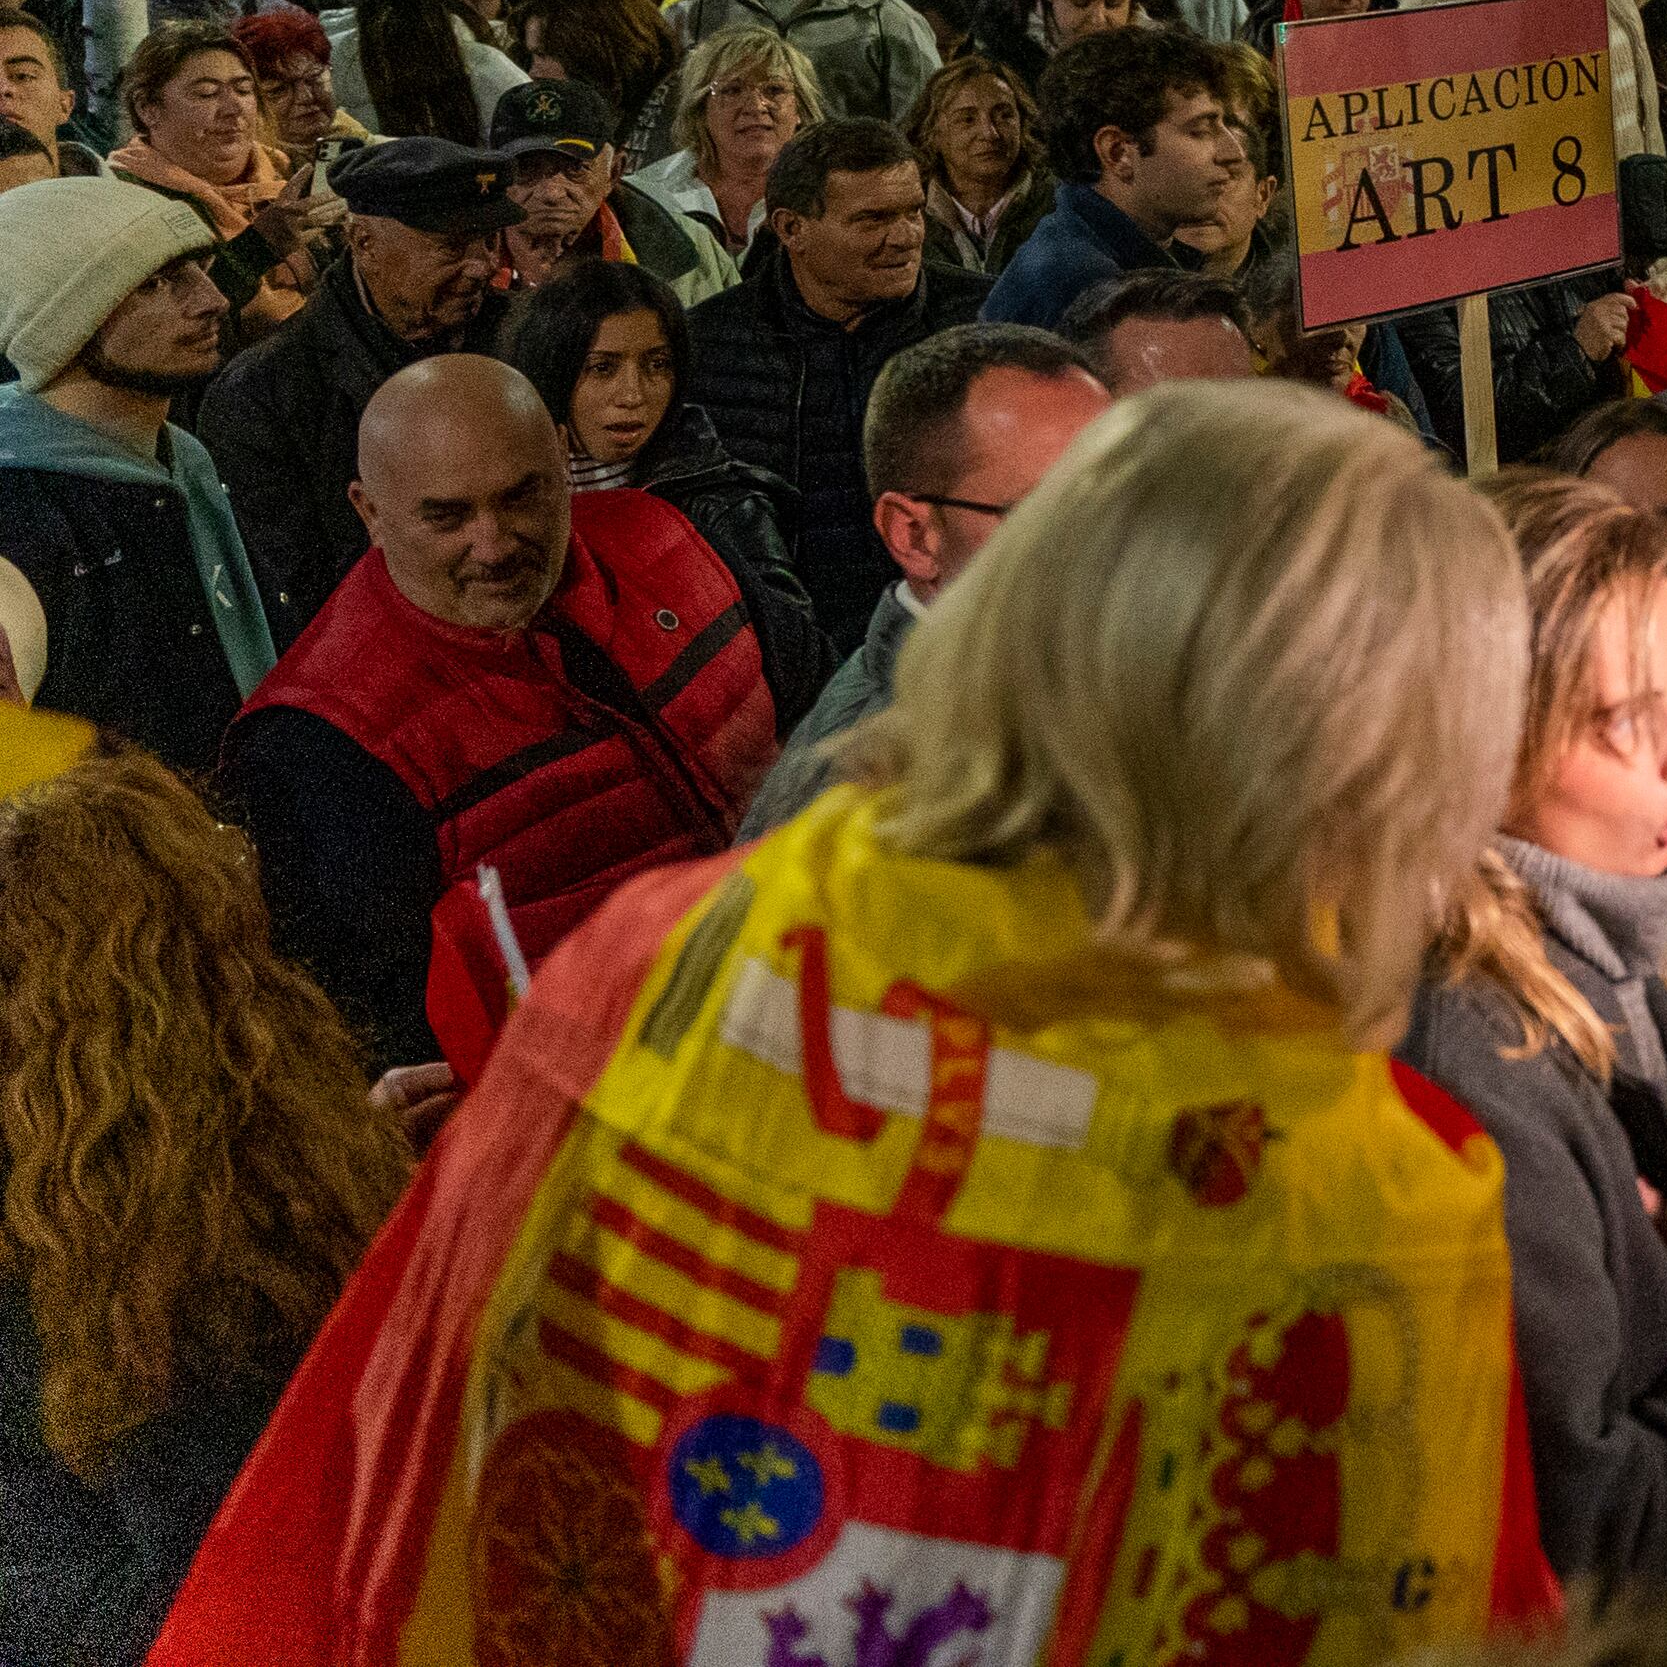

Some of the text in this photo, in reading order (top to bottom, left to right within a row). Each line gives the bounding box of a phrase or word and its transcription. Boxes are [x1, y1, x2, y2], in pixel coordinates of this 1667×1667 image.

[1301, 53, 1602, 143] APLICACIÓN
[1336, 135, 1588, 252] ART 8
